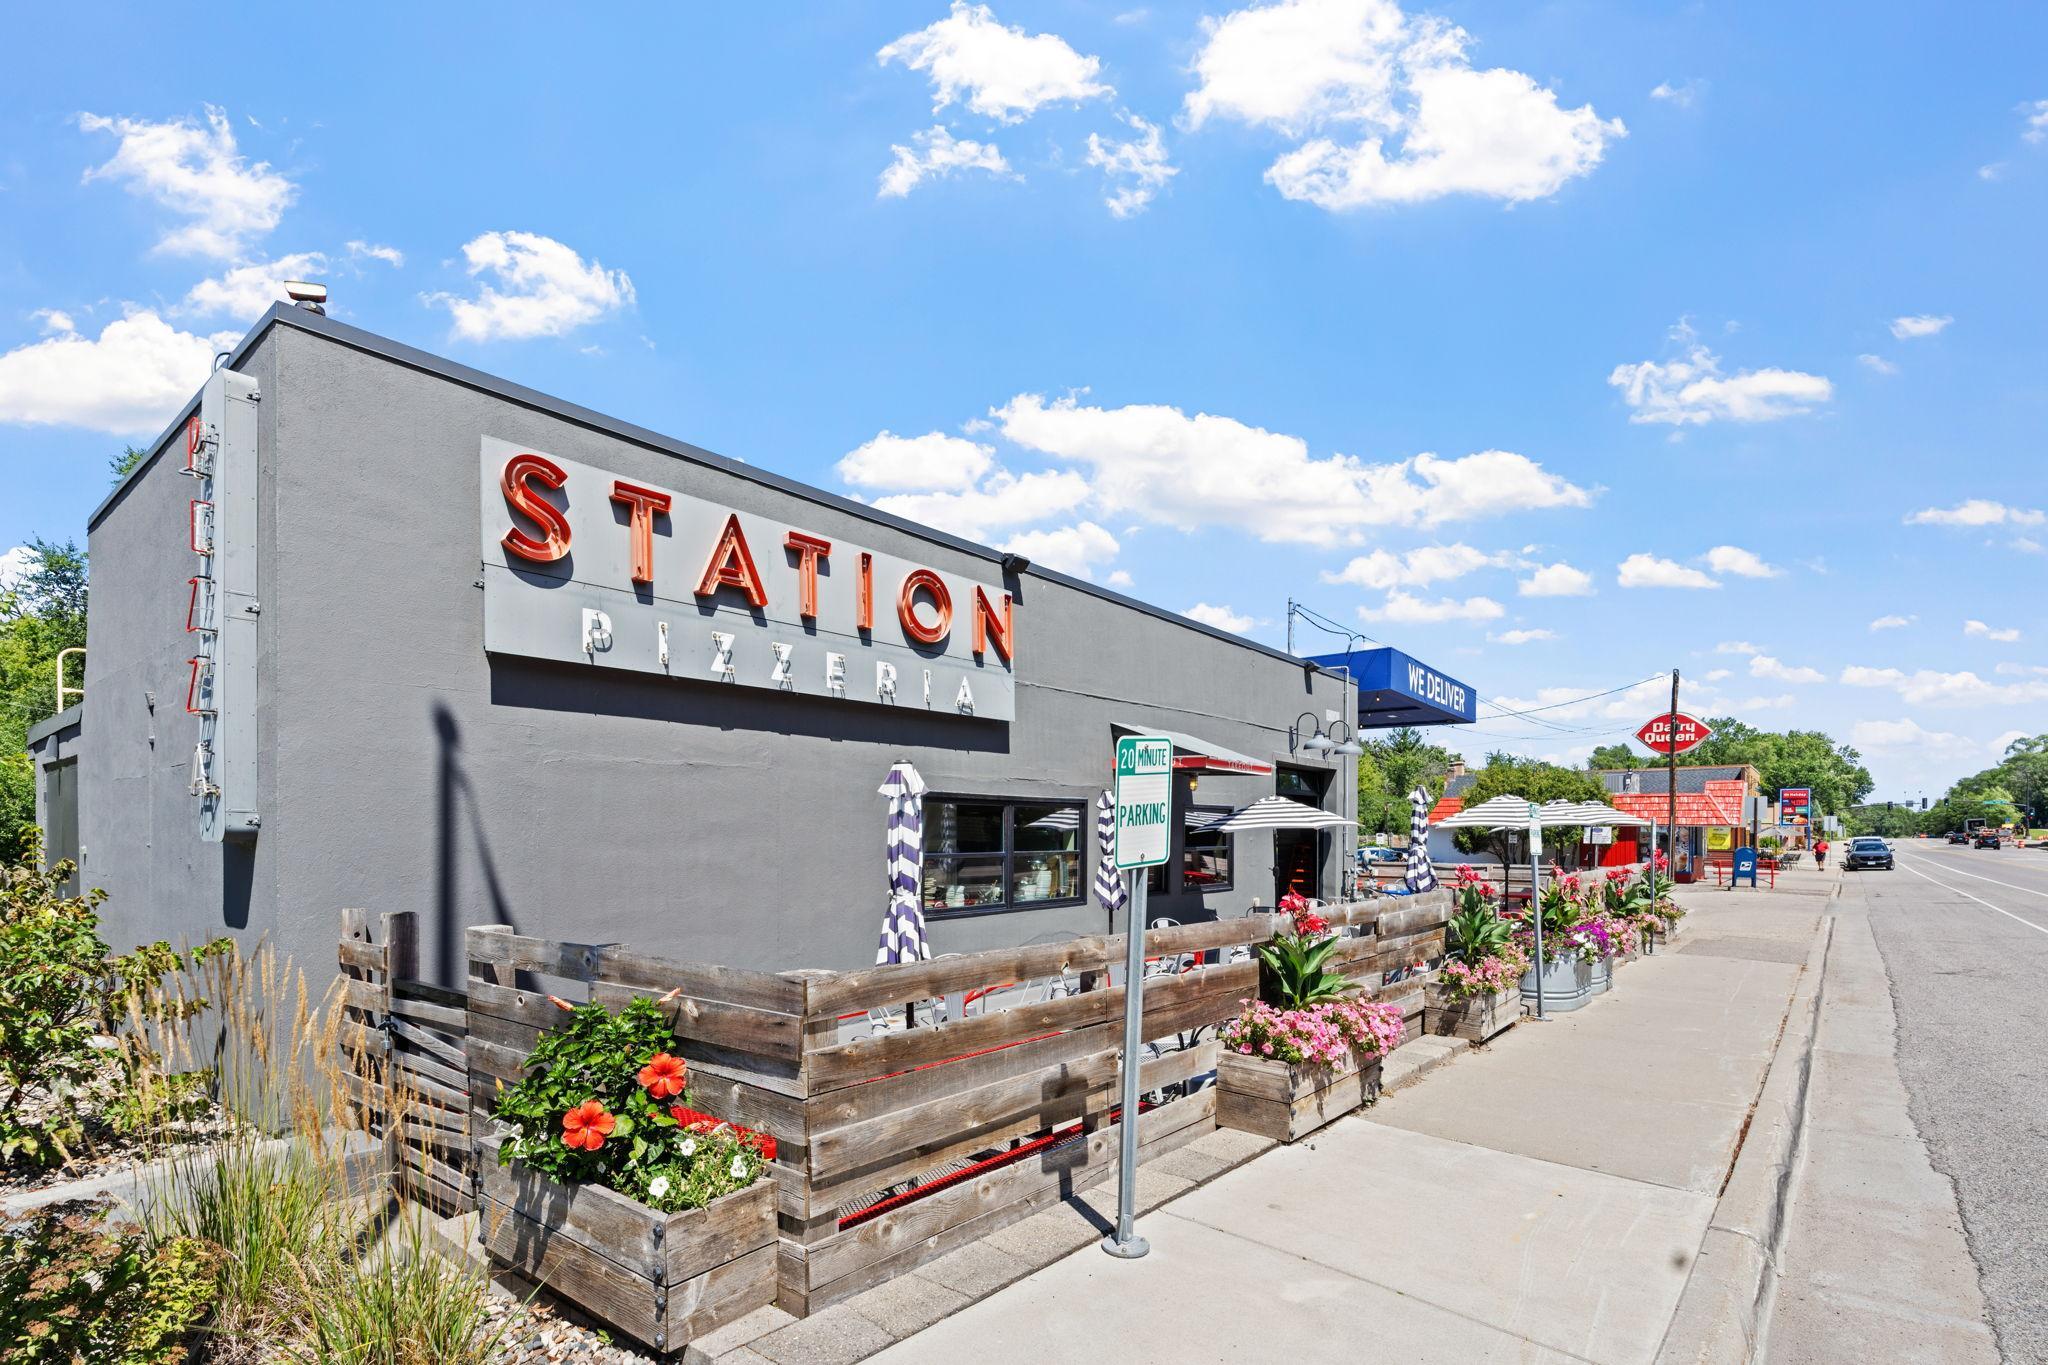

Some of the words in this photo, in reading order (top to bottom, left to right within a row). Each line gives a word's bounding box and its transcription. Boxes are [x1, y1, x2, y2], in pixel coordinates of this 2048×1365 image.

[500, 454, 1014, 661] STATION
[582, 607, 975, 710] PIZZERIA
[1408, 663, 1425, 696] WE
[1427, 672, 1465, 713] DELIVER
[1652, 722, 1695, 733] Dary
[1120, 748, 1135, 769] 20
[1137, 748, 1167, 767] MINUTE
[1120, 802, 1166, 827] PARKING
